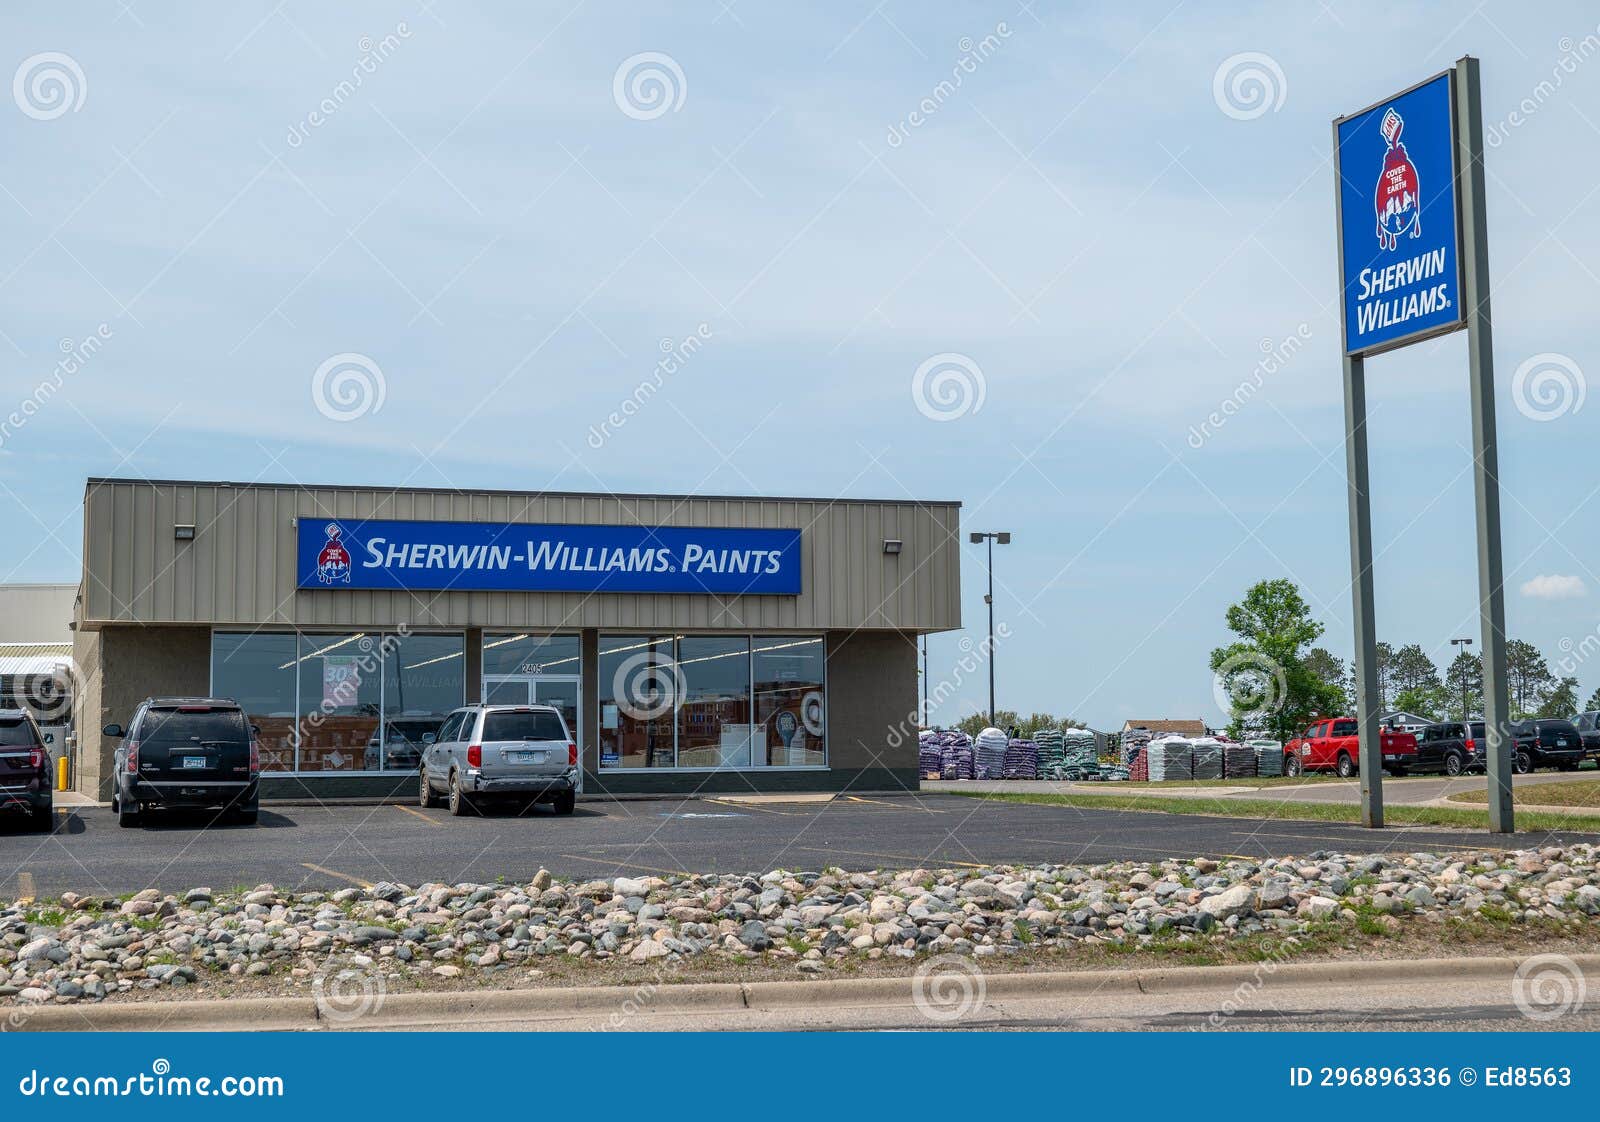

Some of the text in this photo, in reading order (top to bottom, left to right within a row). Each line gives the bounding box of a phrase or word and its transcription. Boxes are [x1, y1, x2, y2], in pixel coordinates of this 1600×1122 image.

[1386, 165, 1406, 179] COVER
[1391, 174, 1403, 185] THE
[1387, 181, 1406, 194] EARTH
[1357, 246, 1446, 301] SHERWIN
[1357, 283, 1448, 335] WILLIAMS
[681, 544, 782, 574] PAINTS
[521, 663, 543, 673] 2405
